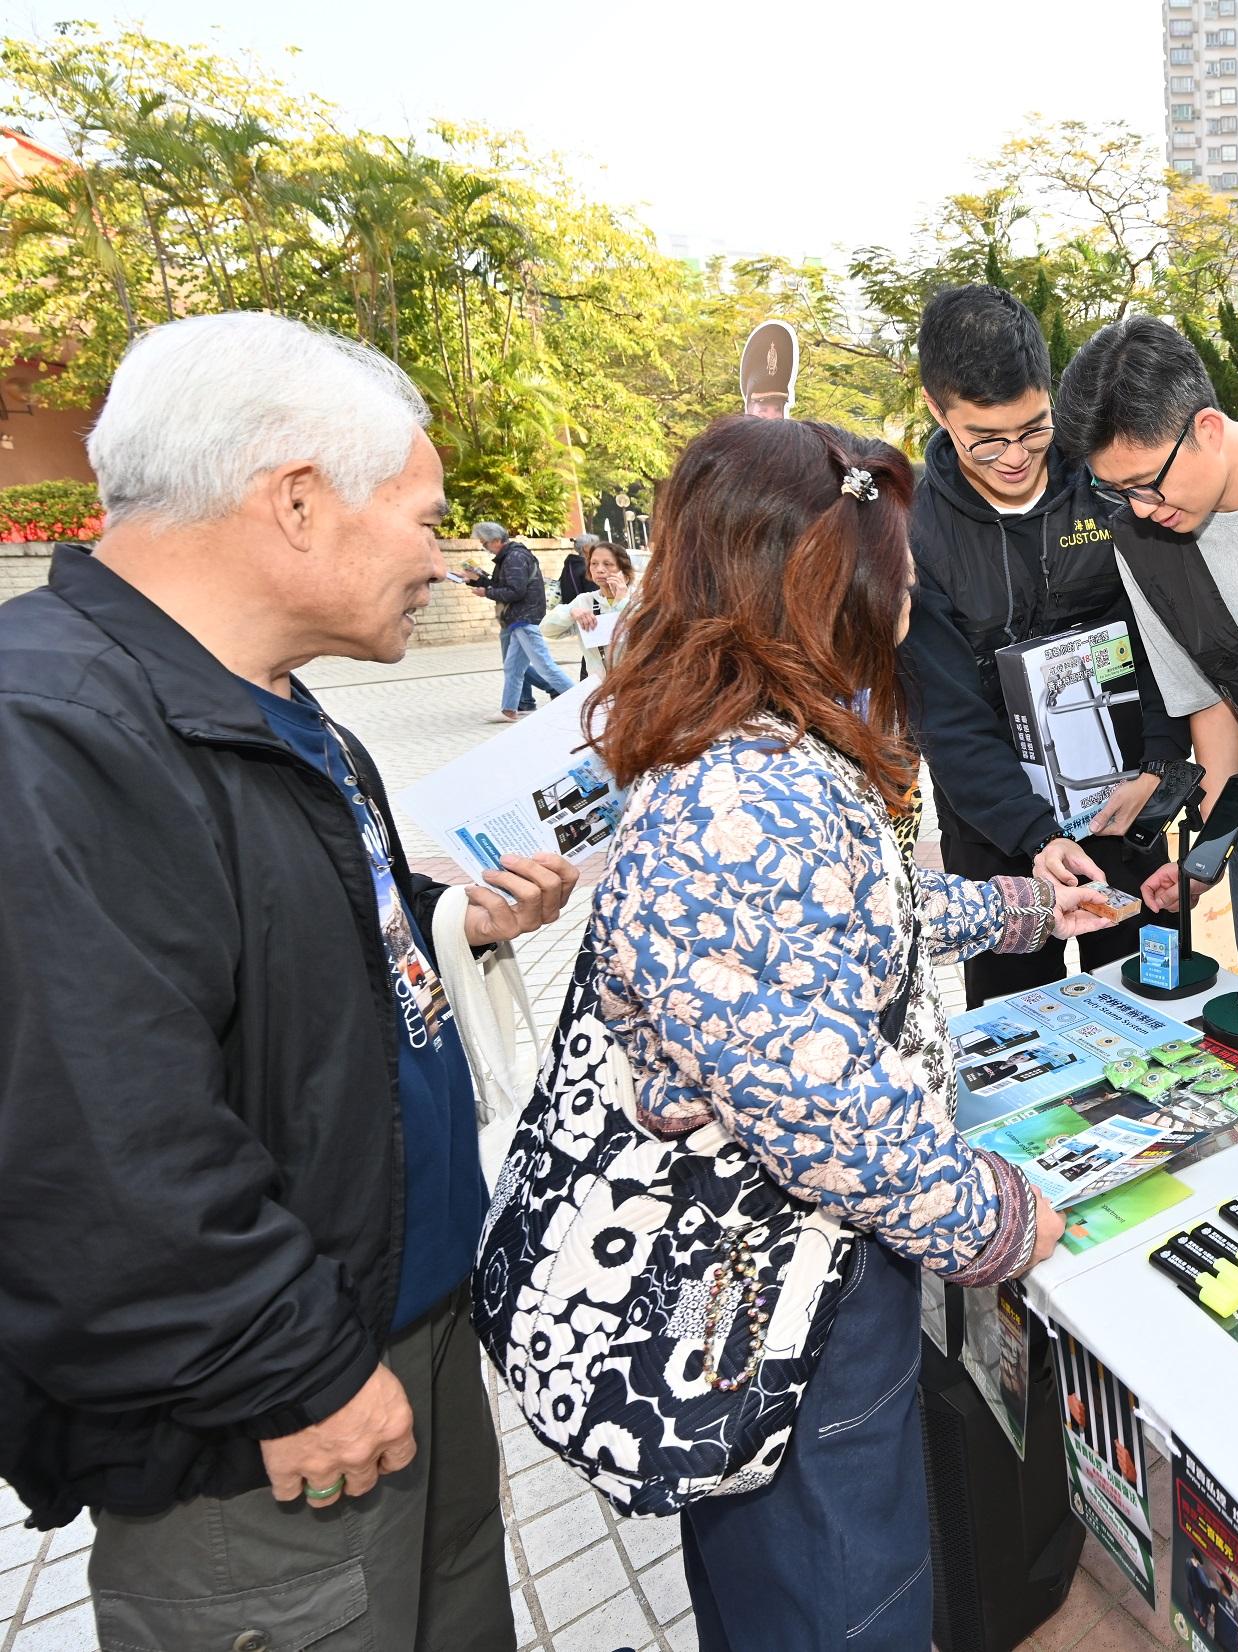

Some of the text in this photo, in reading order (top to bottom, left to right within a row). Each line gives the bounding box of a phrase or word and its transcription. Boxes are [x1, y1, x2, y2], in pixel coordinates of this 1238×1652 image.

[1083, 998, 1149, 1035] Duty Stamp System
